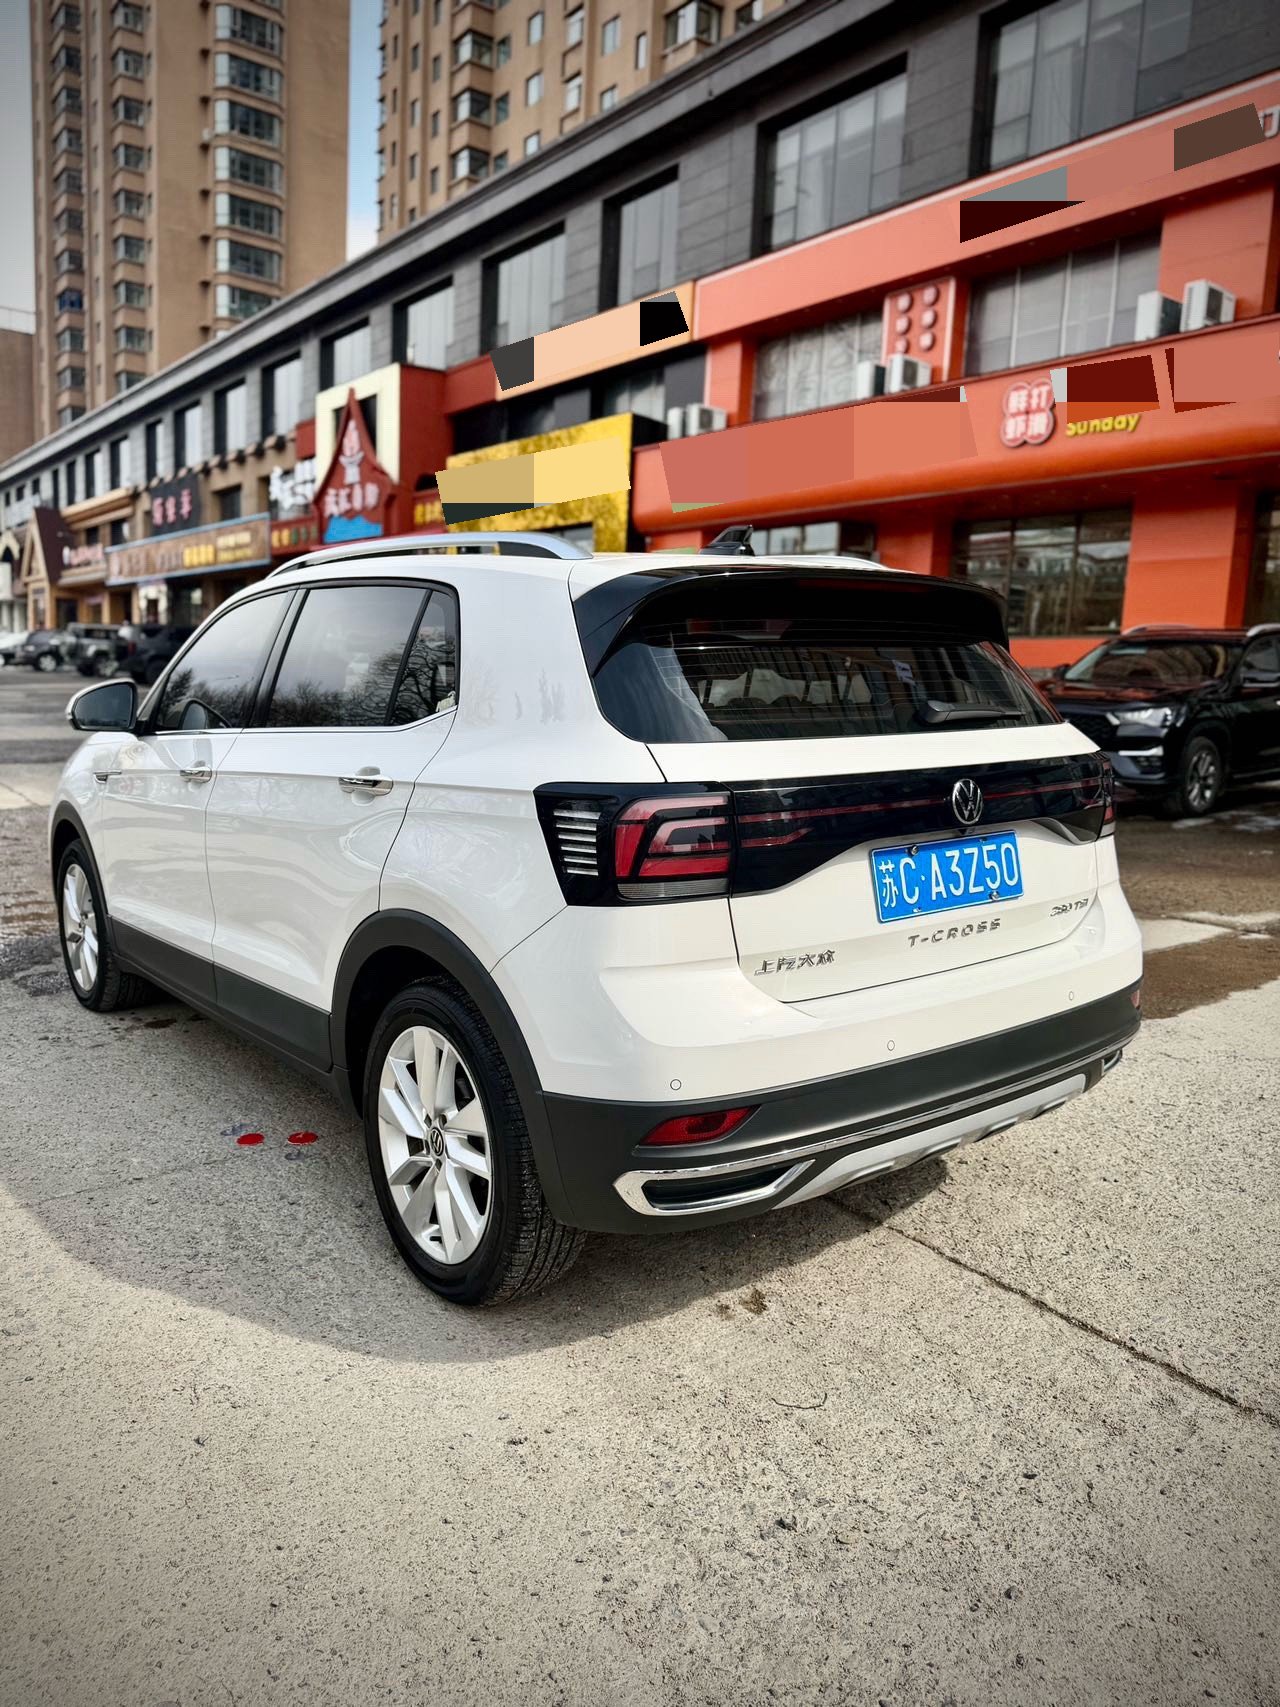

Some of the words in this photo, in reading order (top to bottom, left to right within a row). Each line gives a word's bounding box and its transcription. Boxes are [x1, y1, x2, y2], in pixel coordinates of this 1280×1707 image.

[907, 918, 1001, 948] T-CROSS
[754, 949, 836, 977] 上汽大众
